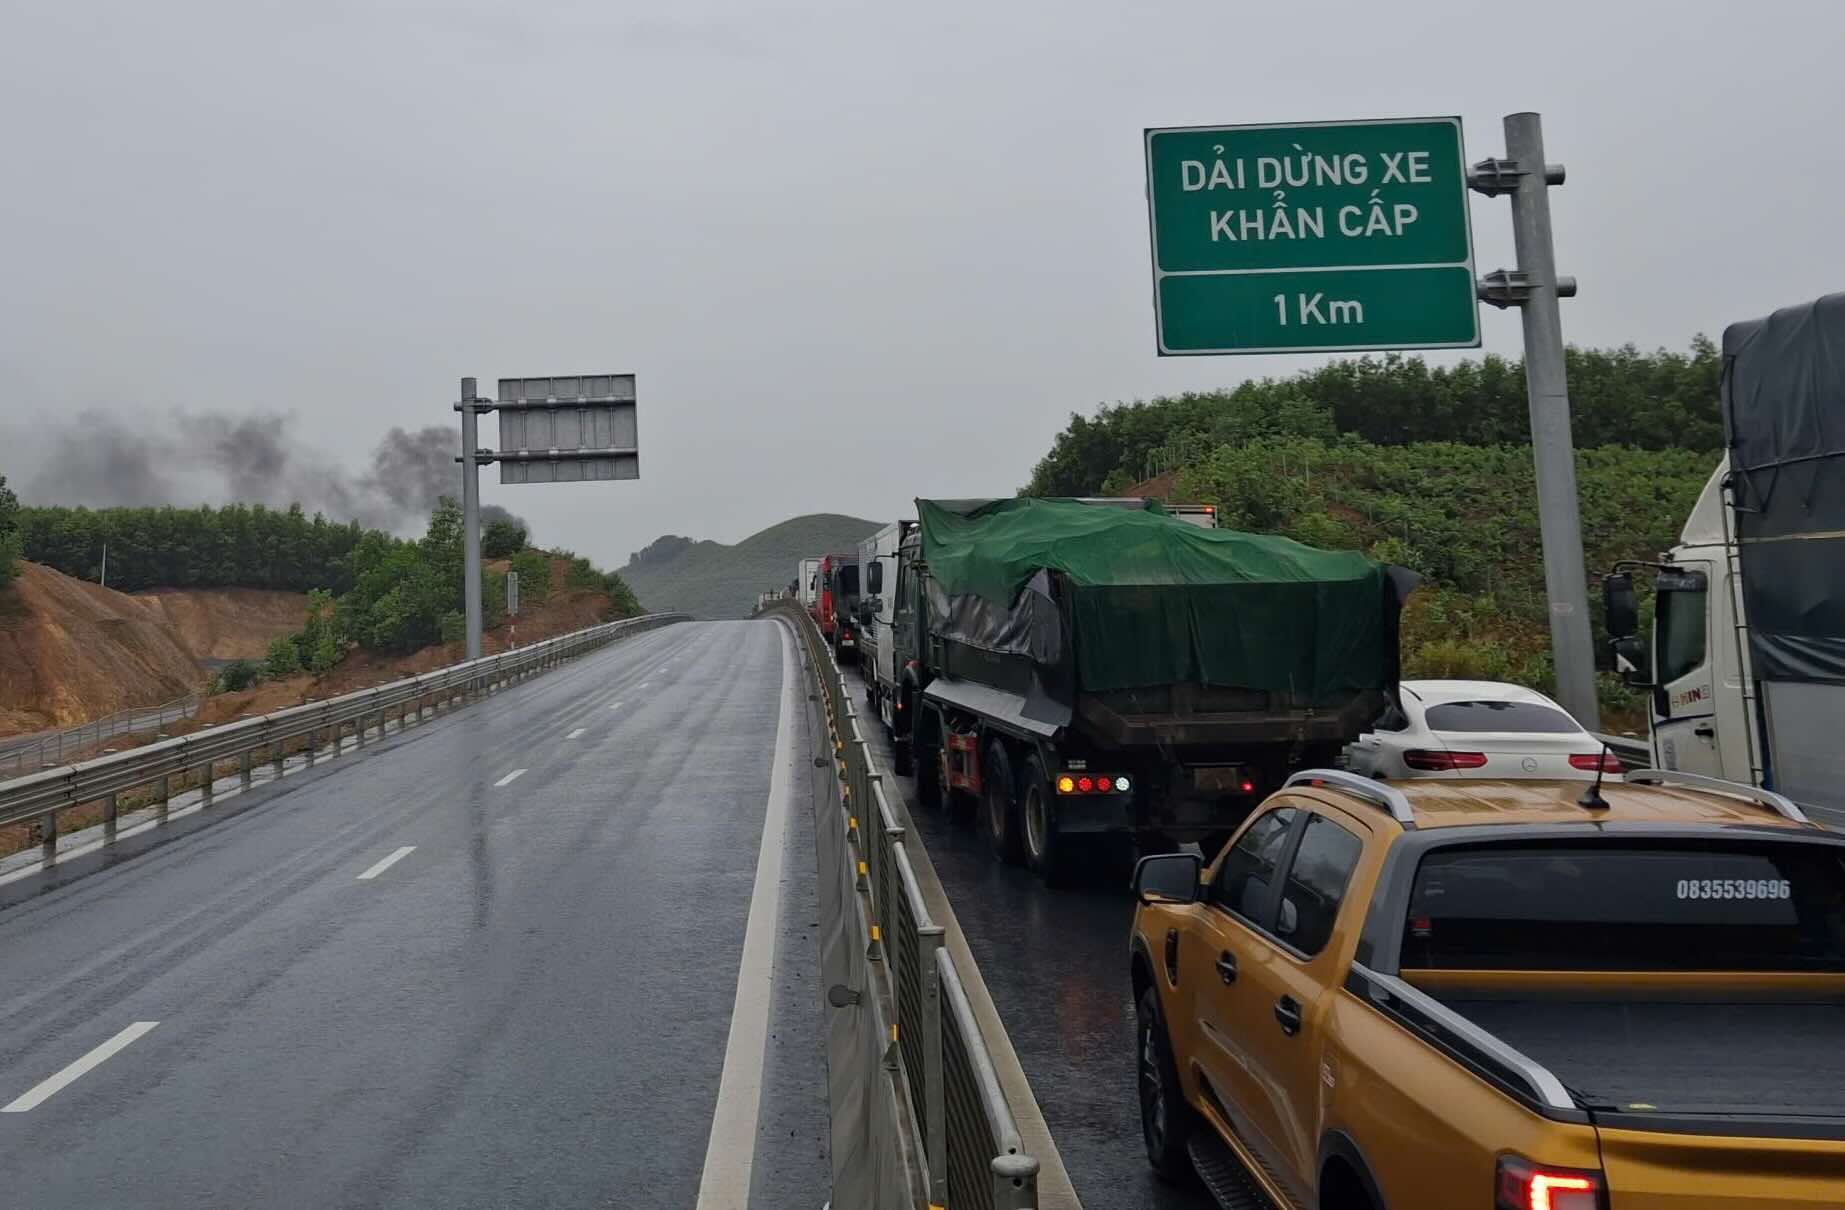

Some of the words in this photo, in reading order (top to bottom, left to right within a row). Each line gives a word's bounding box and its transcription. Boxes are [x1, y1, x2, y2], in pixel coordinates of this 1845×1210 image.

[1181, 144, 1246, 192] DẢI
[1257, 143, 1368, 188] DỪNG
[1379, 151, 1432, 184] XE
[1210, 190, 1325, 241] KHẨN
[1338, 188, 1419, 237] CẤP
[1273, 294, 1287, 325] 1
[1298, 292, 1364, 325] Km
[1677, 879, 1791, 899] 0835539696
